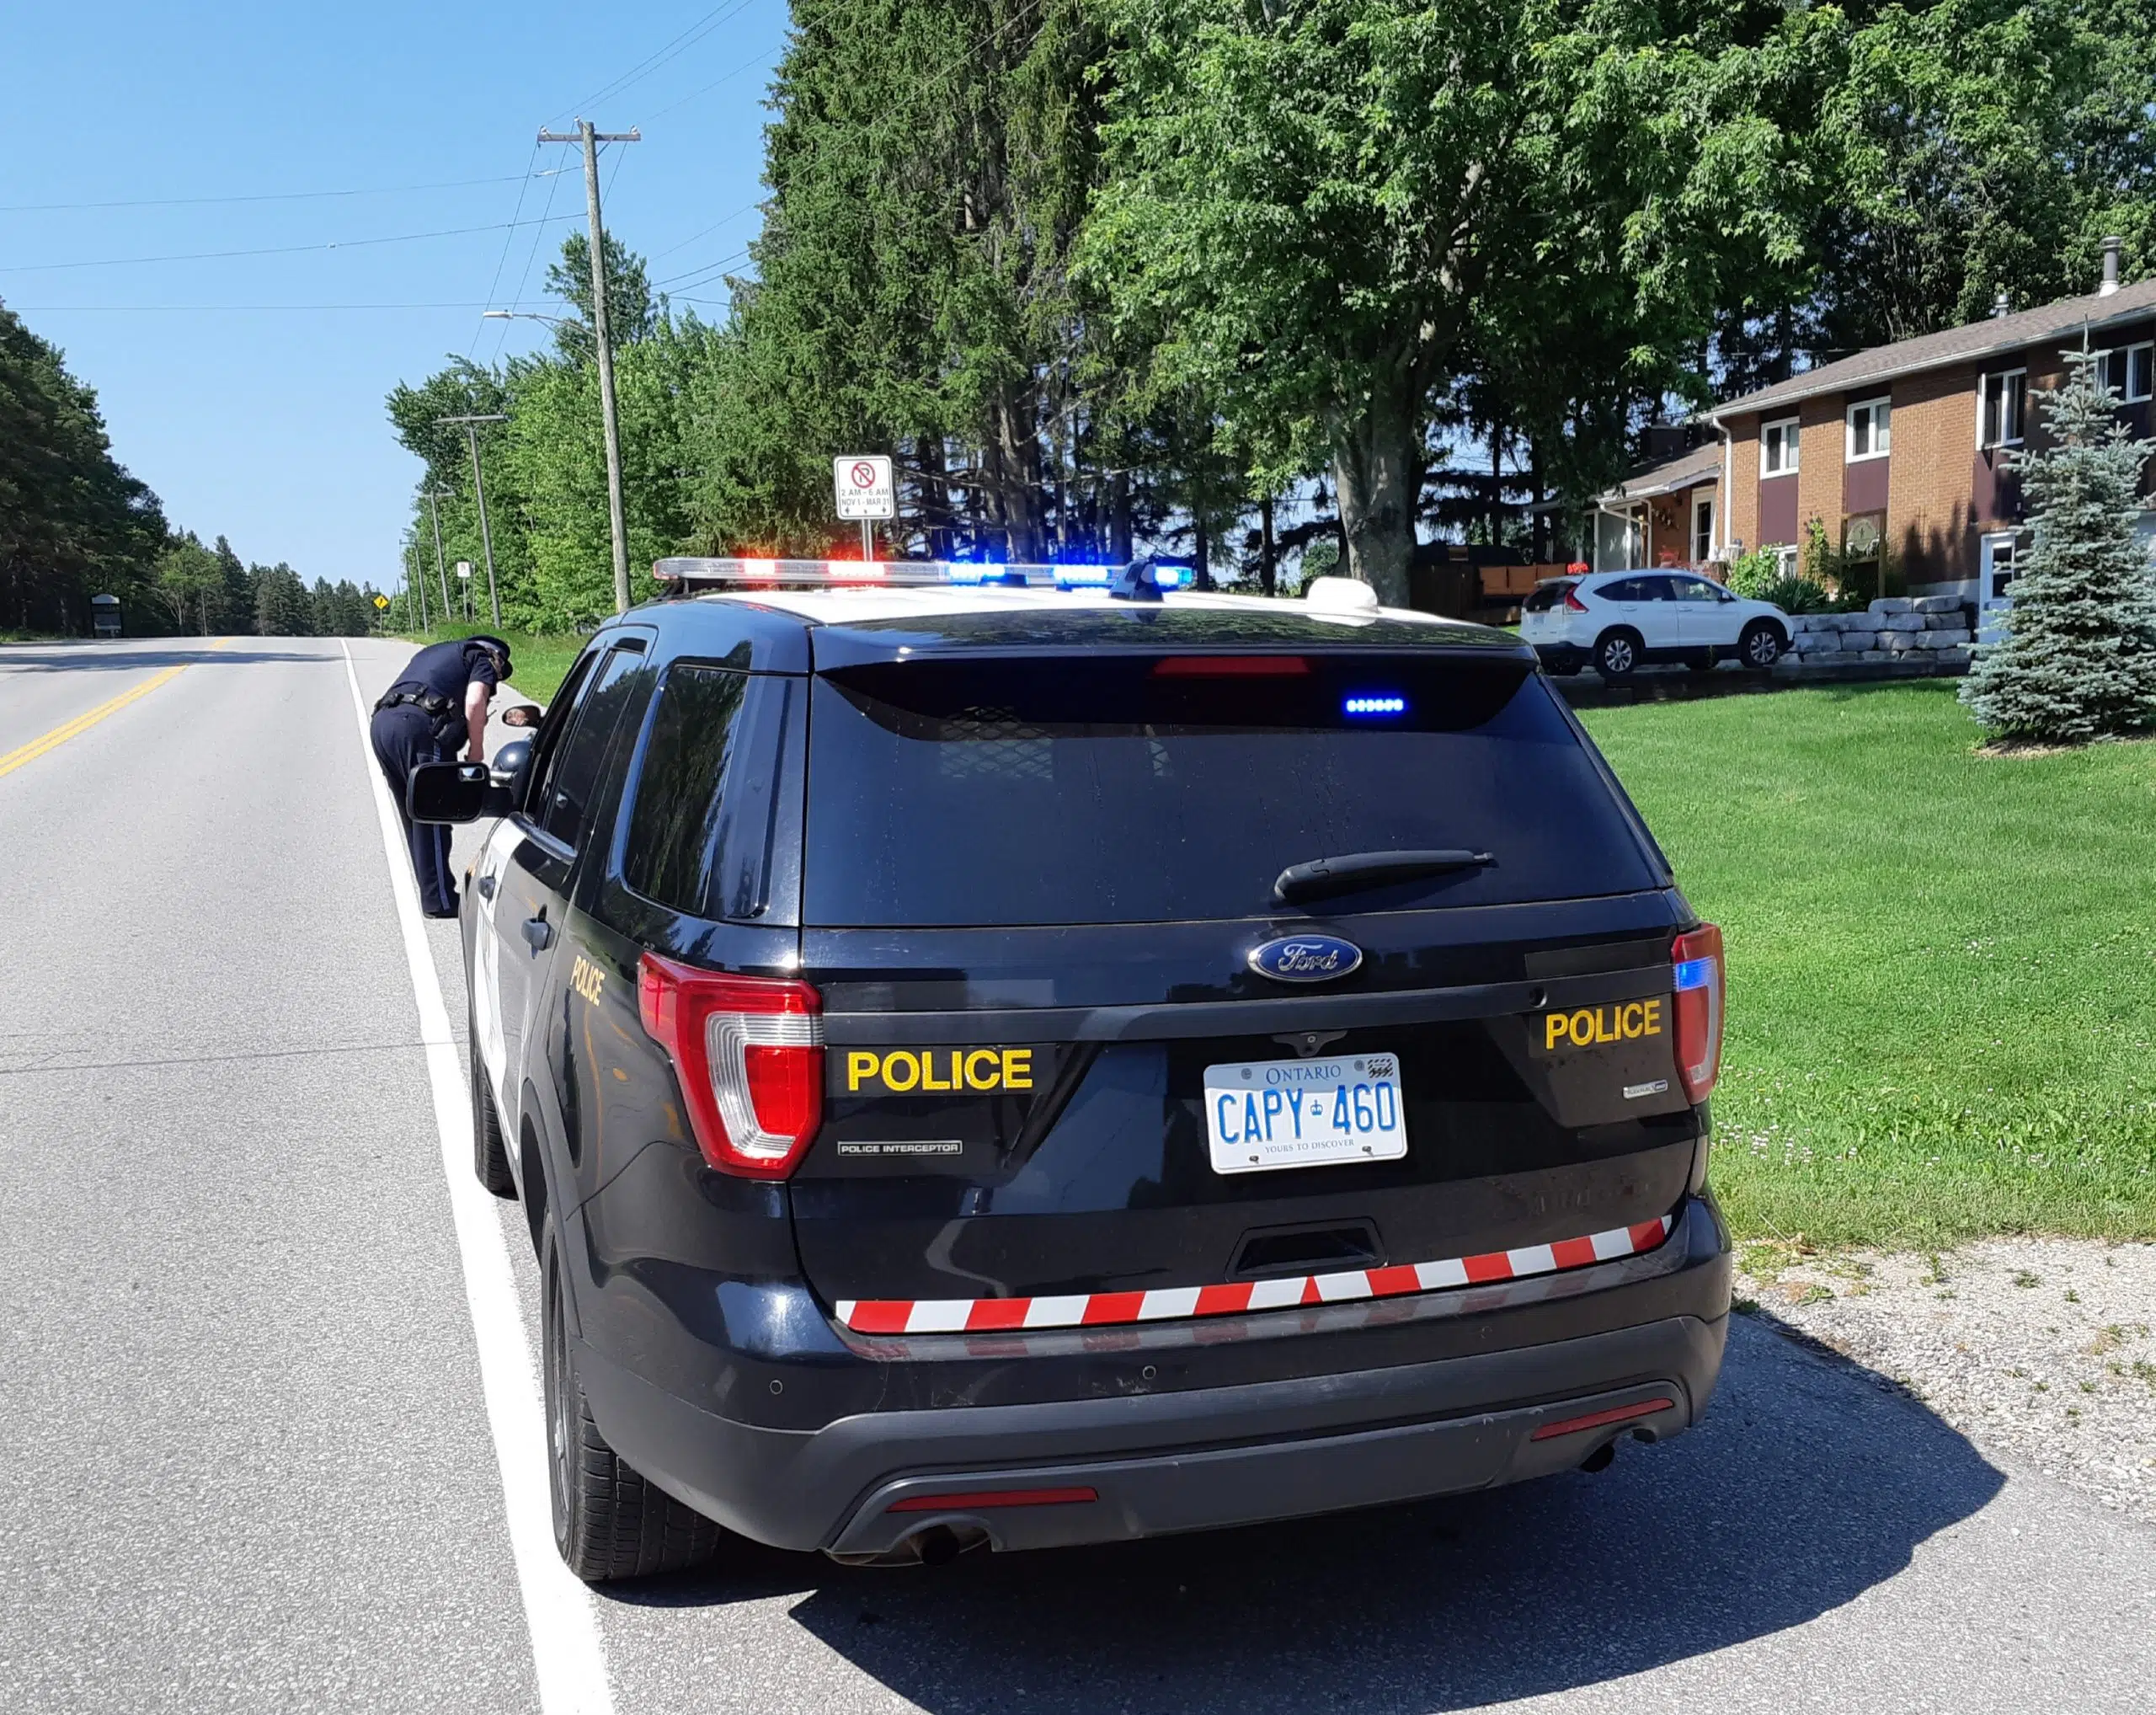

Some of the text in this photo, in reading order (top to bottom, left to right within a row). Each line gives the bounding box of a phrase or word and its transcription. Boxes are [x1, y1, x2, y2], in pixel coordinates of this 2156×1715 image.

[1278, 943, 1338, 971] Ford
[569, 954, 606, 1007] POLICE
[1545, 1000, 1661, 1050] POLICE
[847, 1049, 1033, 1092] POLICE
[1217, 1082, 1396, 1144] CAPY 460
[841, 1144, 958, 1153] POLICE INTERCEPTOR
[1265, 1139, 1354, 1154] YOURS TO DISCOVER
